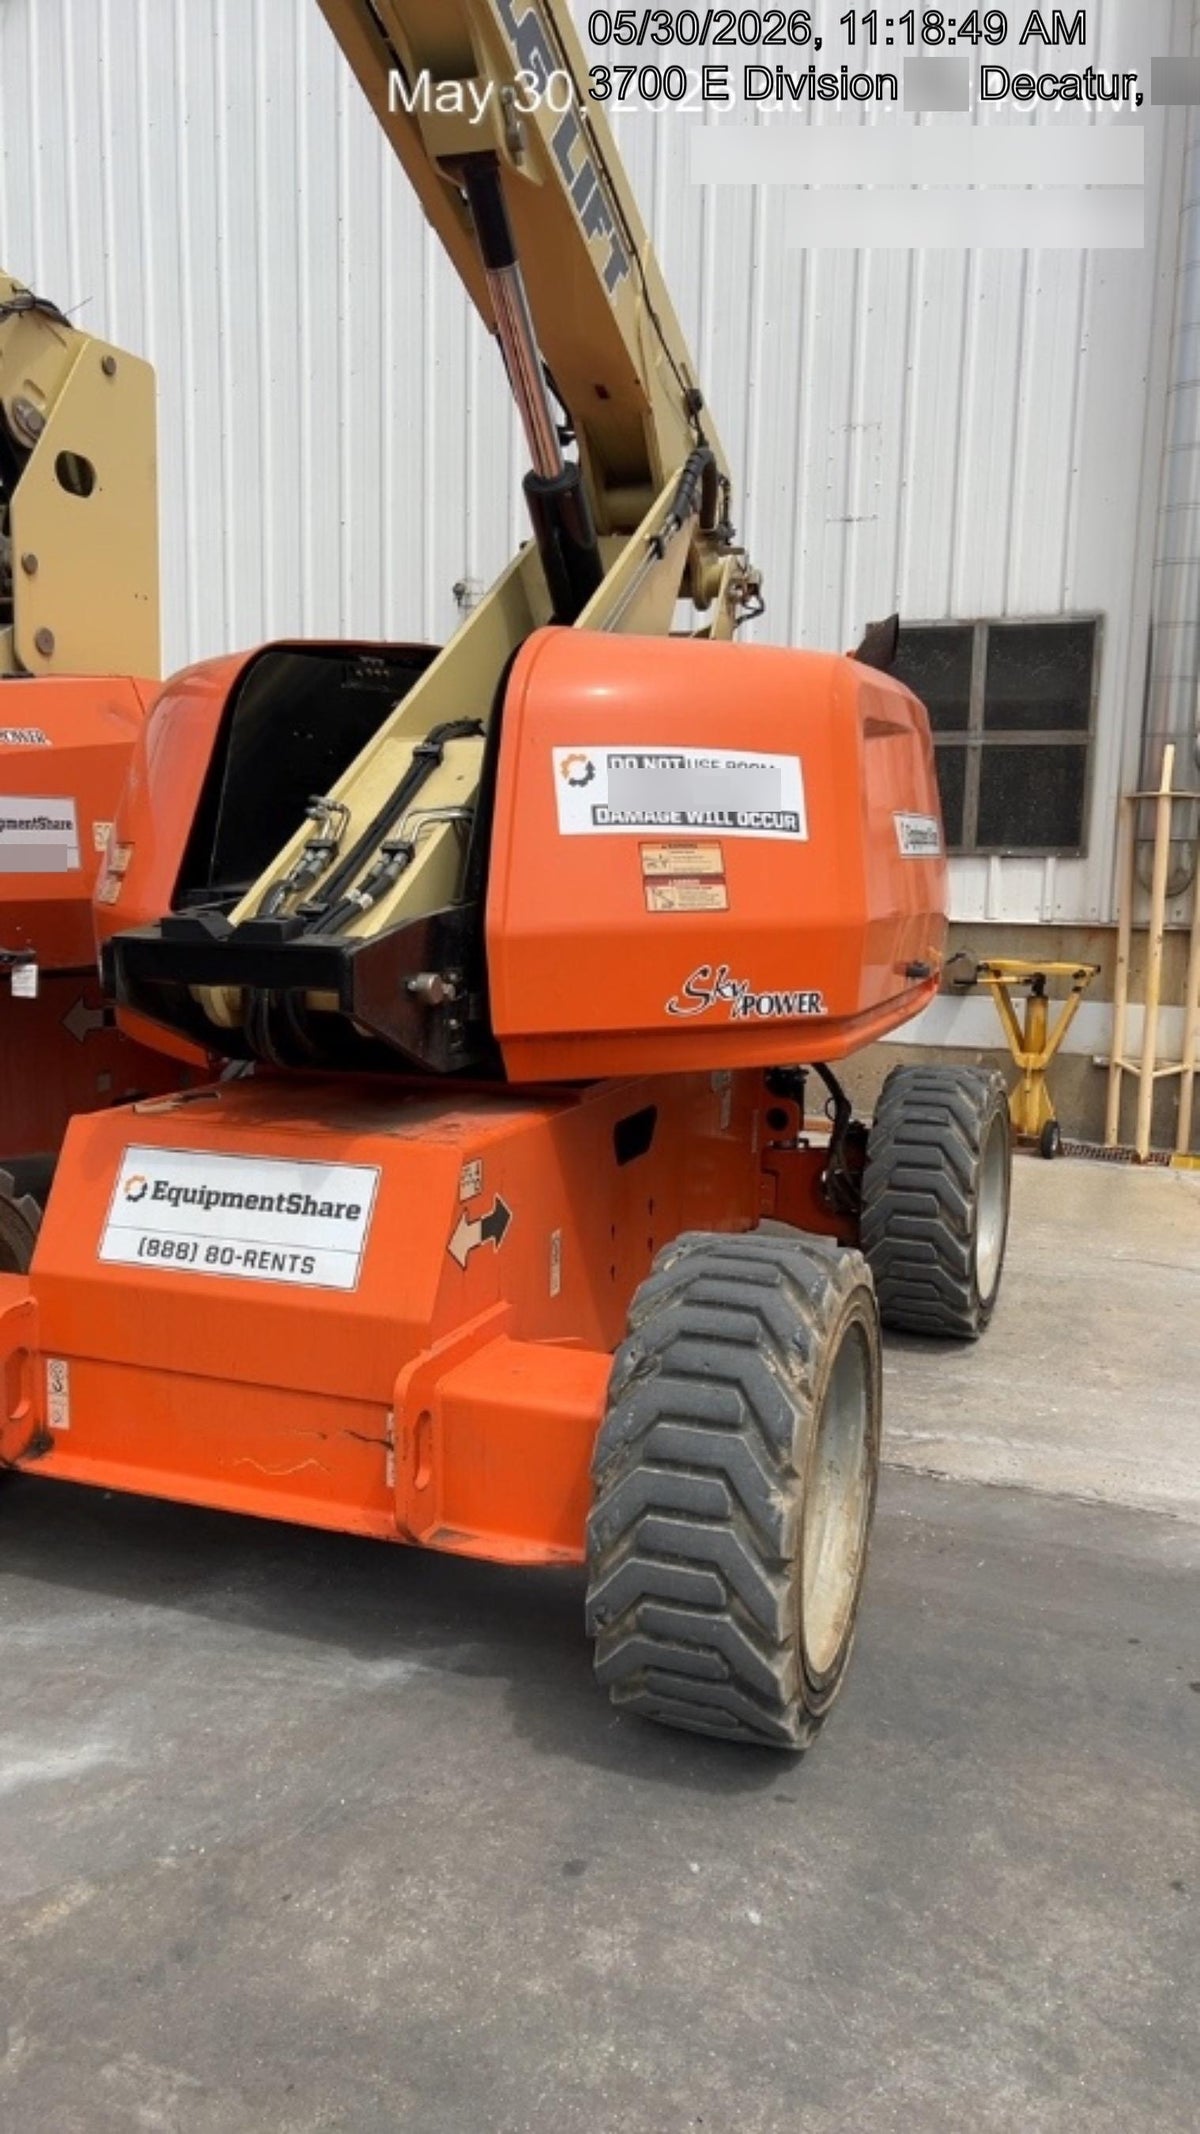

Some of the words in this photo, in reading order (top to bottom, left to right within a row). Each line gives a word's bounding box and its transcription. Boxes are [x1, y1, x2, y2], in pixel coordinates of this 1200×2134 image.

[595, 807, 682, 824] DAMAGE
[686, 811, 734, 826] WILL
[737, 812, 798, 831] OCCUR
[740, 991, 823, 1017] POWER
[151, 1179, 362, 1221] EquipmentShare
[137, 1236, 199, 1263] (888)
[204, 1244, 316, 1275] 80-RENTS
